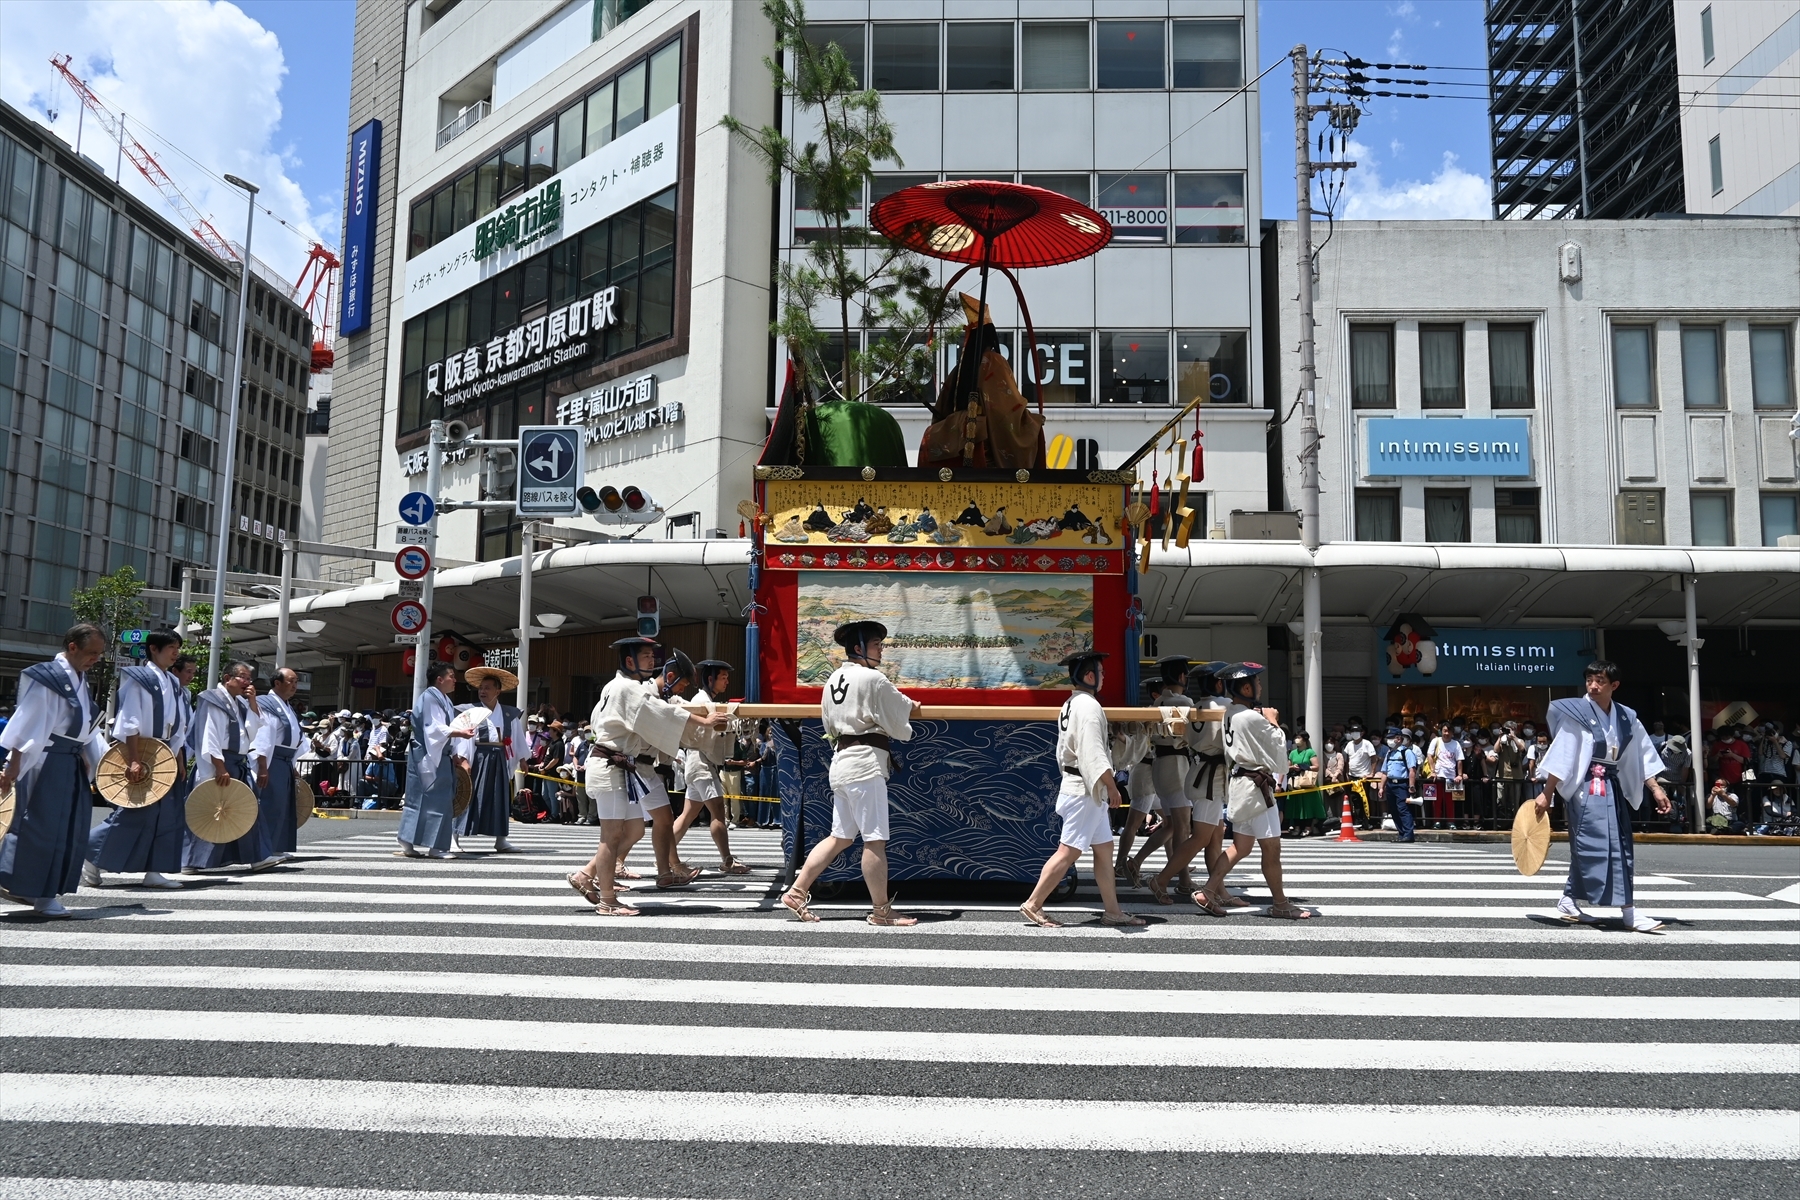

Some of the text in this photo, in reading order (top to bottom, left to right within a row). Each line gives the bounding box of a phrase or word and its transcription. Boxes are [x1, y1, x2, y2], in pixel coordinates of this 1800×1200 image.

[354, 139, 368, 216] MIZUHO
[570, 142, 664, 205] コンタクト・補聴器
[474, 178, 562, 262] 眼鏡市場
[347, 245, 359, 318] みずほ銀行
[411, 248, 476, 293] メガネ・サングラス
[444, 286, 618, 392] 阪急 京都河原町駅
[443, 342, 587, 408] Hankyu Kyoto-kawaramachi Station
[1380, 439, 1519, 454] intimissimi
[523, 491, 574, 503] 路線バスを除く
[132, 632, 140, 640] 32
[1476, 662, 1555, 674] Italian lingerie
